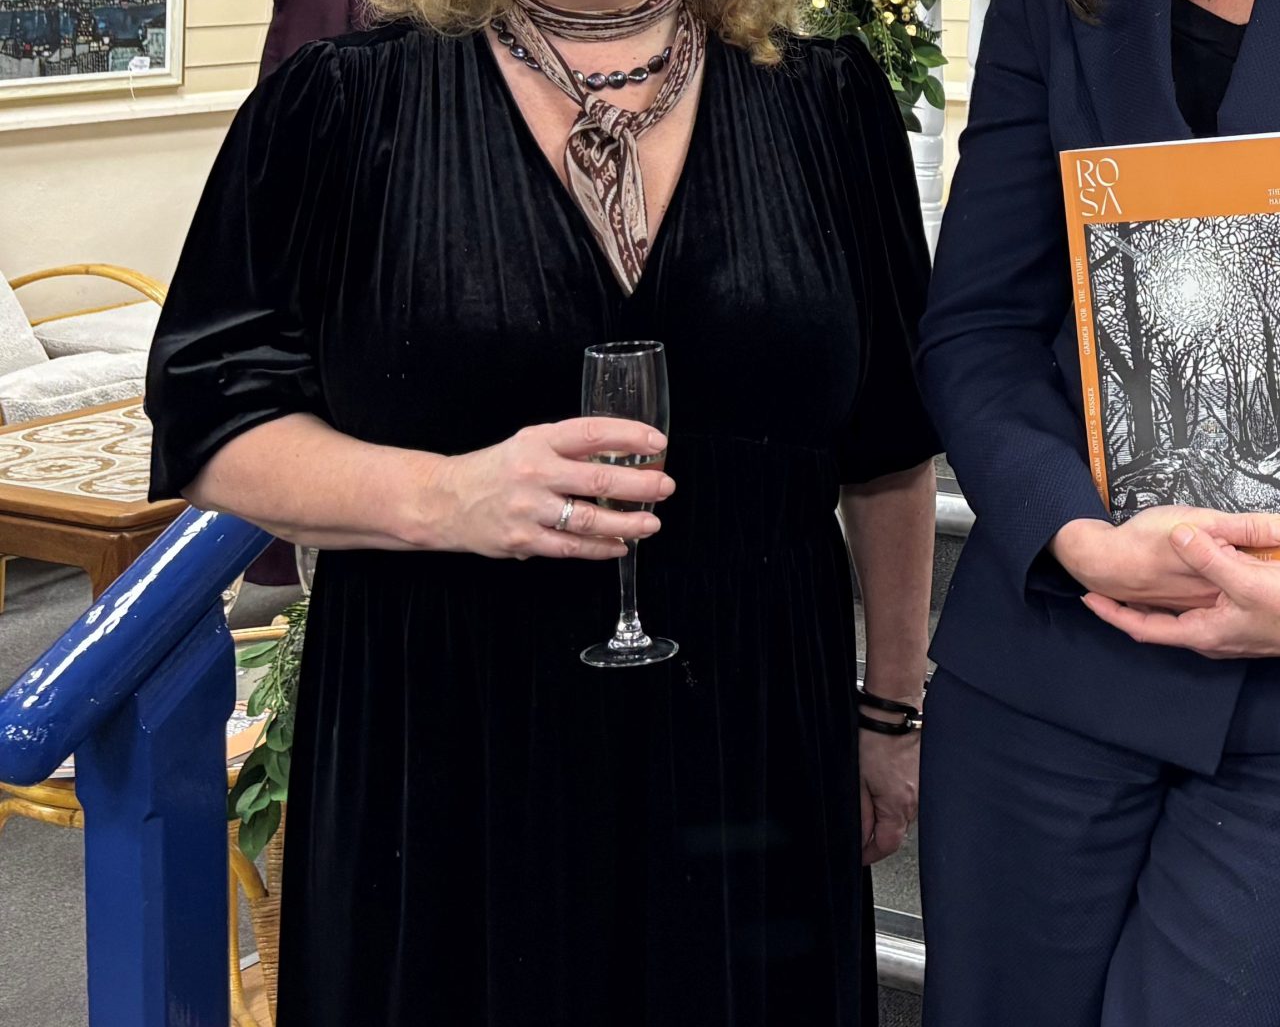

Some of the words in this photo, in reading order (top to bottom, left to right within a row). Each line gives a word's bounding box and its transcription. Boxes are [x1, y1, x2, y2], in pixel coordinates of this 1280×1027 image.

[1076, 157, 1119, 188] RO
[1075, 256, 1084, 285] FUTURE
[1078, 289, 1086, 303] THE
[1080, 307, 1088, 322] FOR
[1081, 326, 1091, 355] GARDEN
[1087, 387, 1096, 417] SUSSEX
[1094, 457, 1102, 482] CONAN
